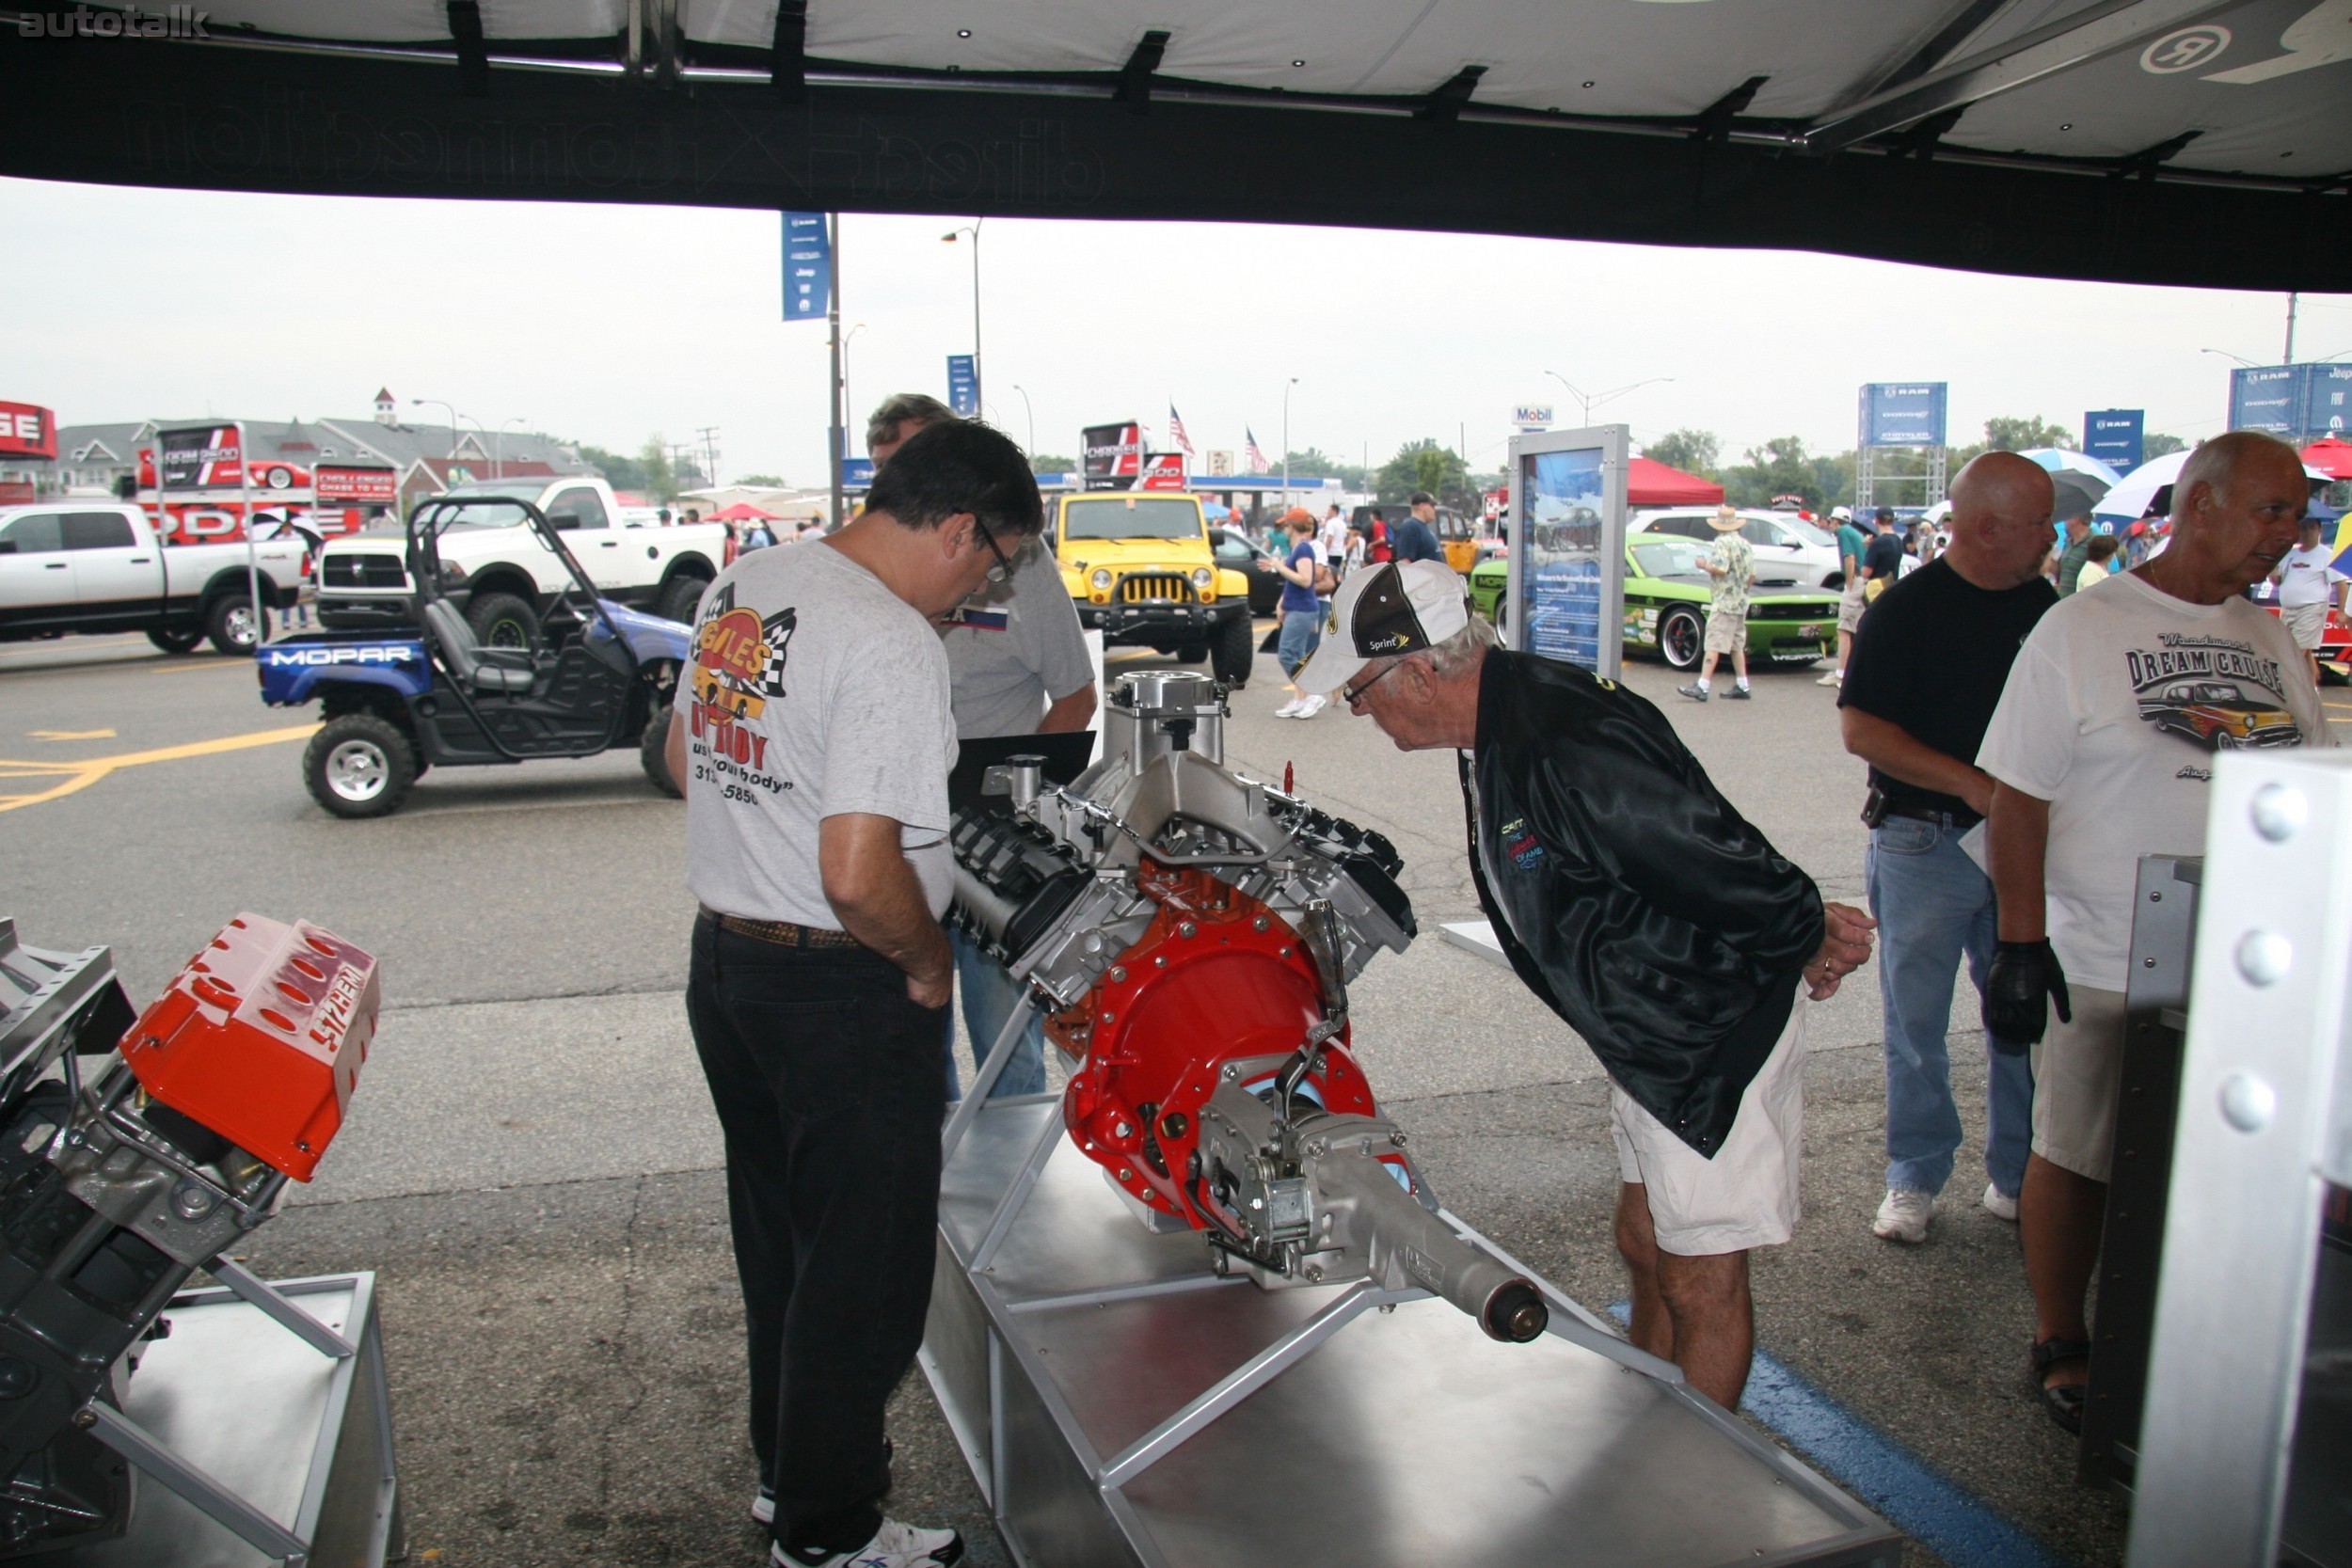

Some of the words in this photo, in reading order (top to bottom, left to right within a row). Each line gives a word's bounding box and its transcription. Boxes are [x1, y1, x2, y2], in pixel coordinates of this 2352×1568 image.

[2260, 372, 2290, 381] RAM
[1518, 408, 1551, 421] Mobil
[700, 621, 771, 675] GILES
[1370, 637, 1396, 651] Sprint
[2158, 632, 2254, 655] Woodward
[271, 646, 411, 667] MOPAR
[2124, 649, 2211, 692] DREAM
[2215, 649, 2286, 702] CRUISE
